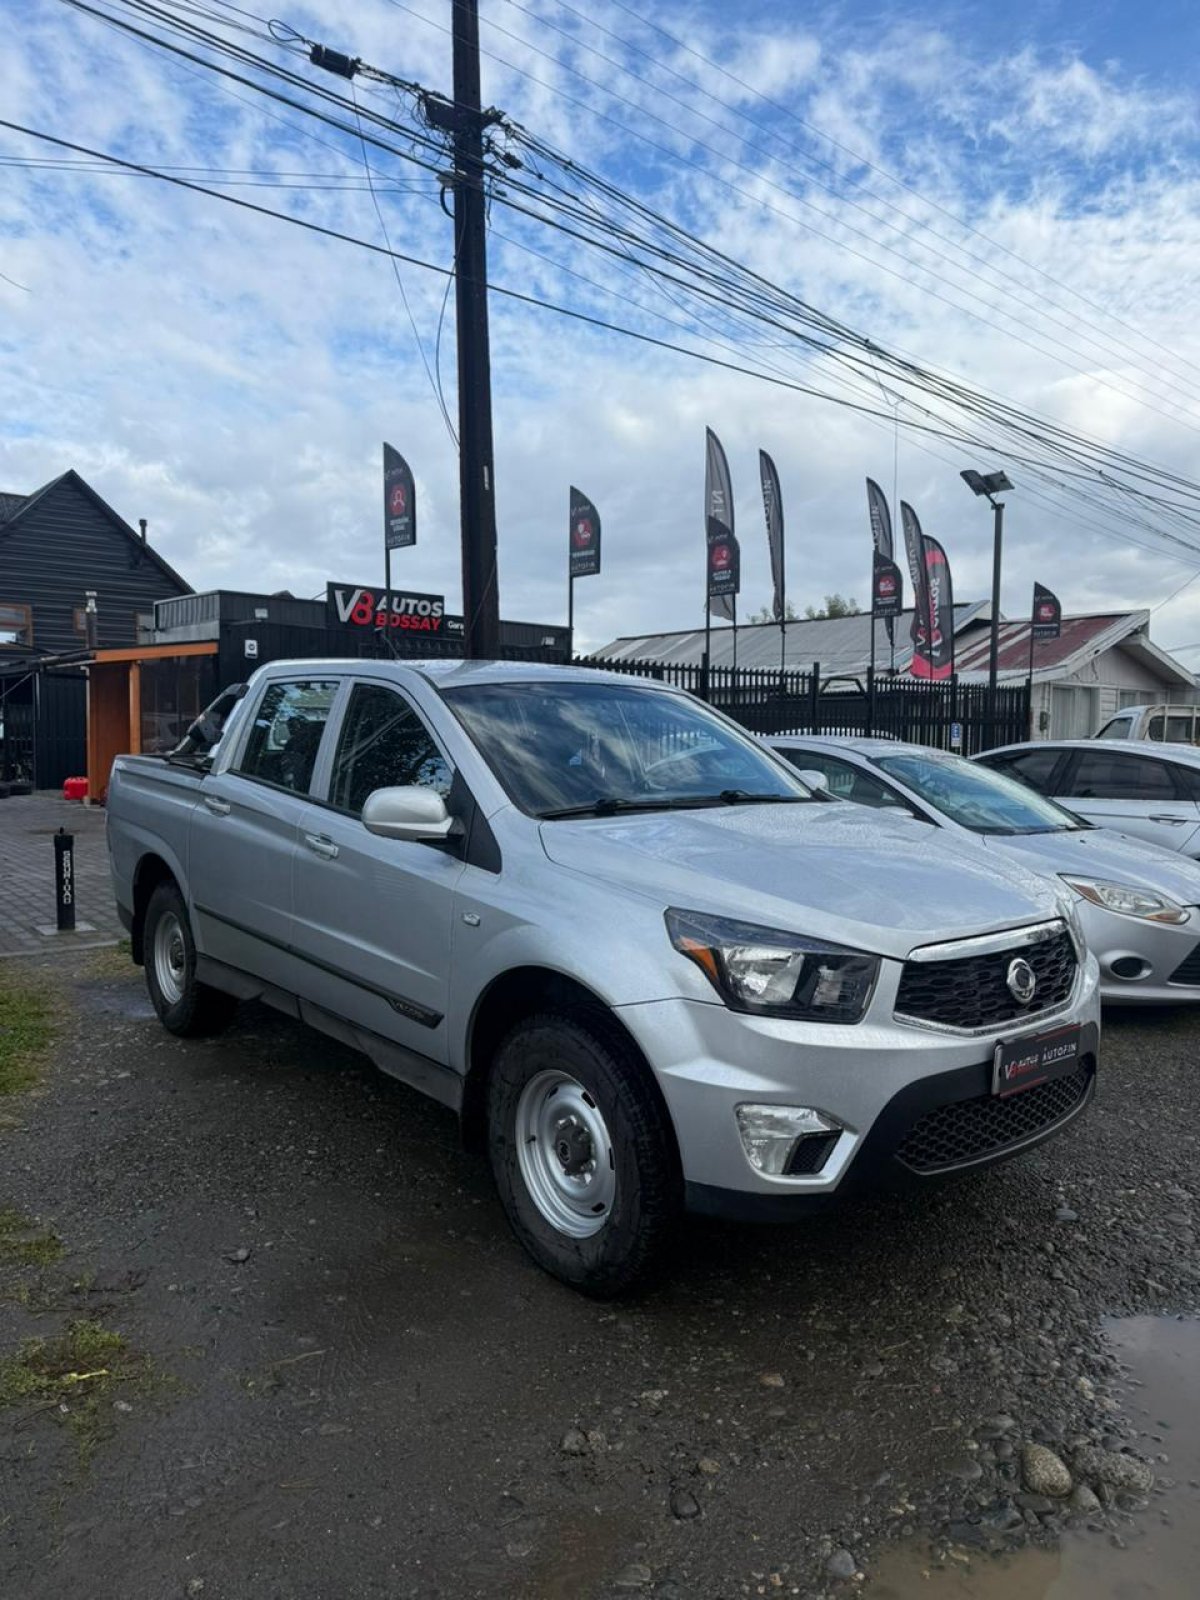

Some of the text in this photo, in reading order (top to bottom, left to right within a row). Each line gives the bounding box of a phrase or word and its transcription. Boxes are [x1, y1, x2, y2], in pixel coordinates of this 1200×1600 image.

[334, 589, 374, 626] V8
[376, 595, 443, 617] AUTOS
[375, 612, 442, 631] BOSSAY
